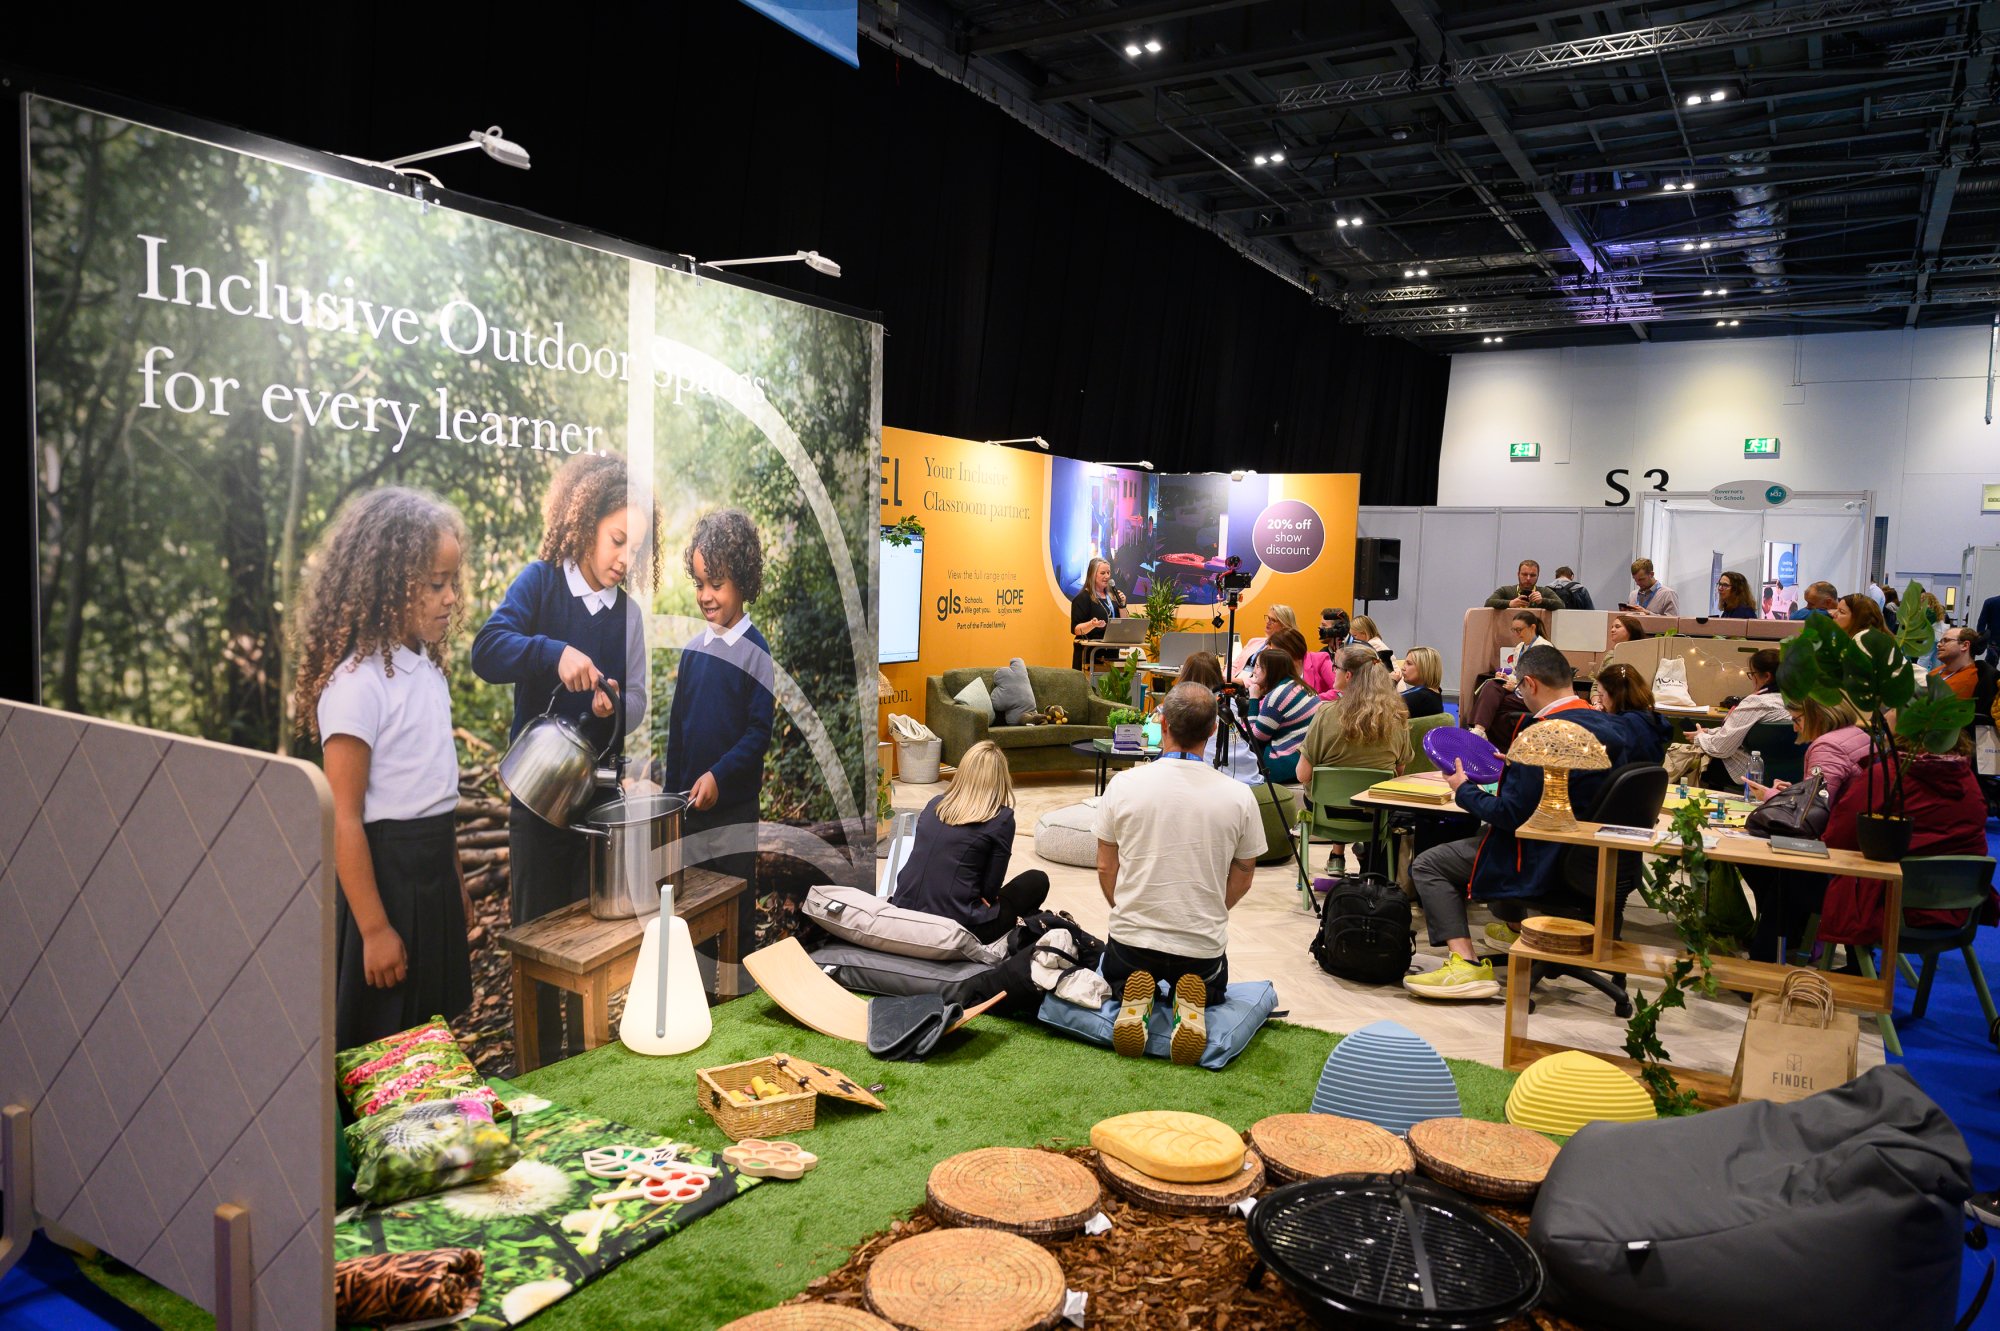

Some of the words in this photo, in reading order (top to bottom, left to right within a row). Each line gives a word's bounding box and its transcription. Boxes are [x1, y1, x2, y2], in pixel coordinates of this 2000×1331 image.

[137, 234, 420, 345] Inclusive
[439, 300, 634, 381] Outdoor
[138, 346, 240, 416] for
[261, 383, 421, 453] every
[435, 387, 607, 458] learner.
[925, 456, 955, 480] Your
[958, 461, 1008, 487] Inclusive
[923, 490, 987, 516] Classroom
[990, 502, 1031, 522] partner.
[1267, 518, 1293, 530] 20%
[1295, 518, 1312, 530] off
[1275, 532, 1303, 542] show
[1265, 544, 1310, 556] discount
[963, 570, 973, 580] the
[937, 589, 964, 621] gls.
[996, 589, 1024, 606] HOPE
[956, 622, 966, 630] Part
[1772, 1071, 1815, 1090] FINDEL
